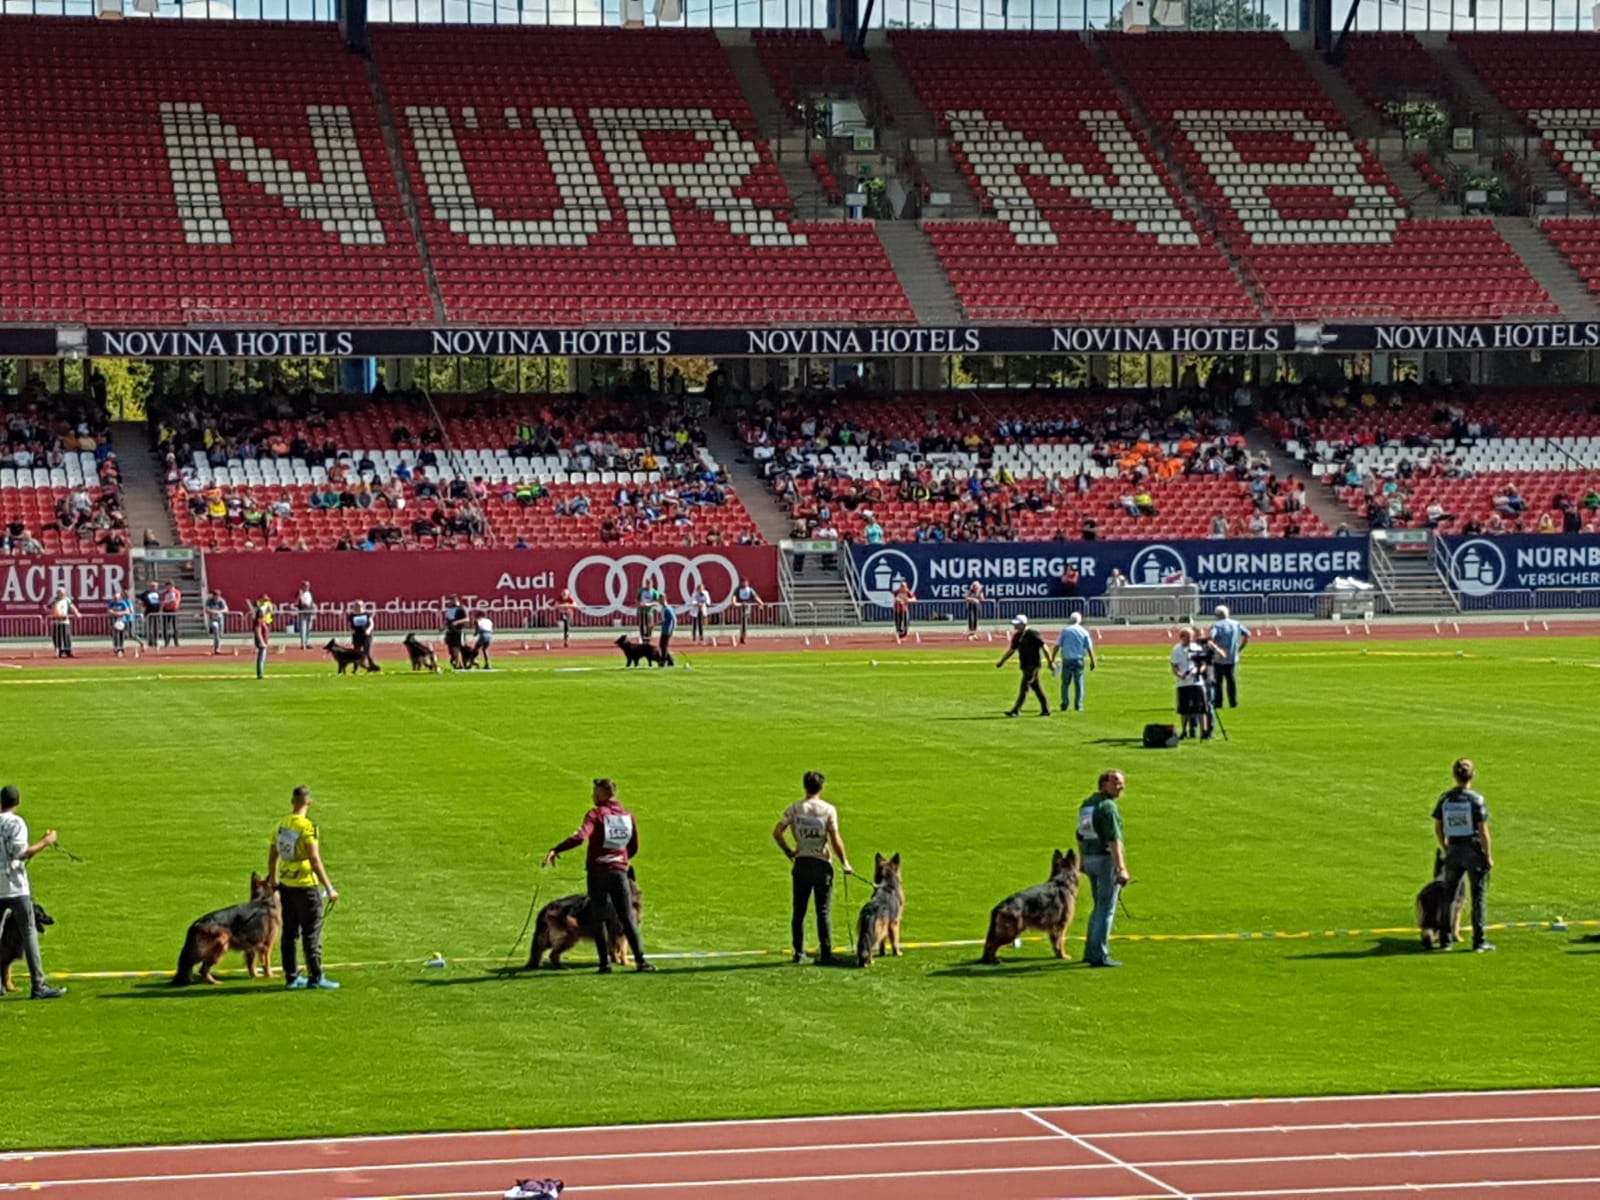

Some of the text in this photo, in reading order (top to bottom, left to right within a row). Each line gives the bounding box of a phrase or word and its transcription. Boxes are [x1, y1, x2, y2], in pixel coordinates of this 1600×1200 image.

[102, 331, 353, 355] NOVINA HOTELS
[431, 330, 671, 354] NOVINA HOTELS
[748, 328, 980, 353] NOVINA HOTELS
[1052, 328, 1279, 350] NOVINA HOTELS
[1375, 324, 1600, 348] NOVINA HOTELS
[1198, 551, 1361, 574] NÜRNBERGER
[1517, 546, 1600, 568] NÜRNB
[1, 564, 125, 602] ACHER
[496, 571, 555, 590] Audi
[1199, 577, 1315, 593] VERSICHERUNG
[1517, 572, 1600, 586] VERSICHER
[930, 583, 1049, 598] VERSHERUNG
[460, 594, 556, 611] Technik
